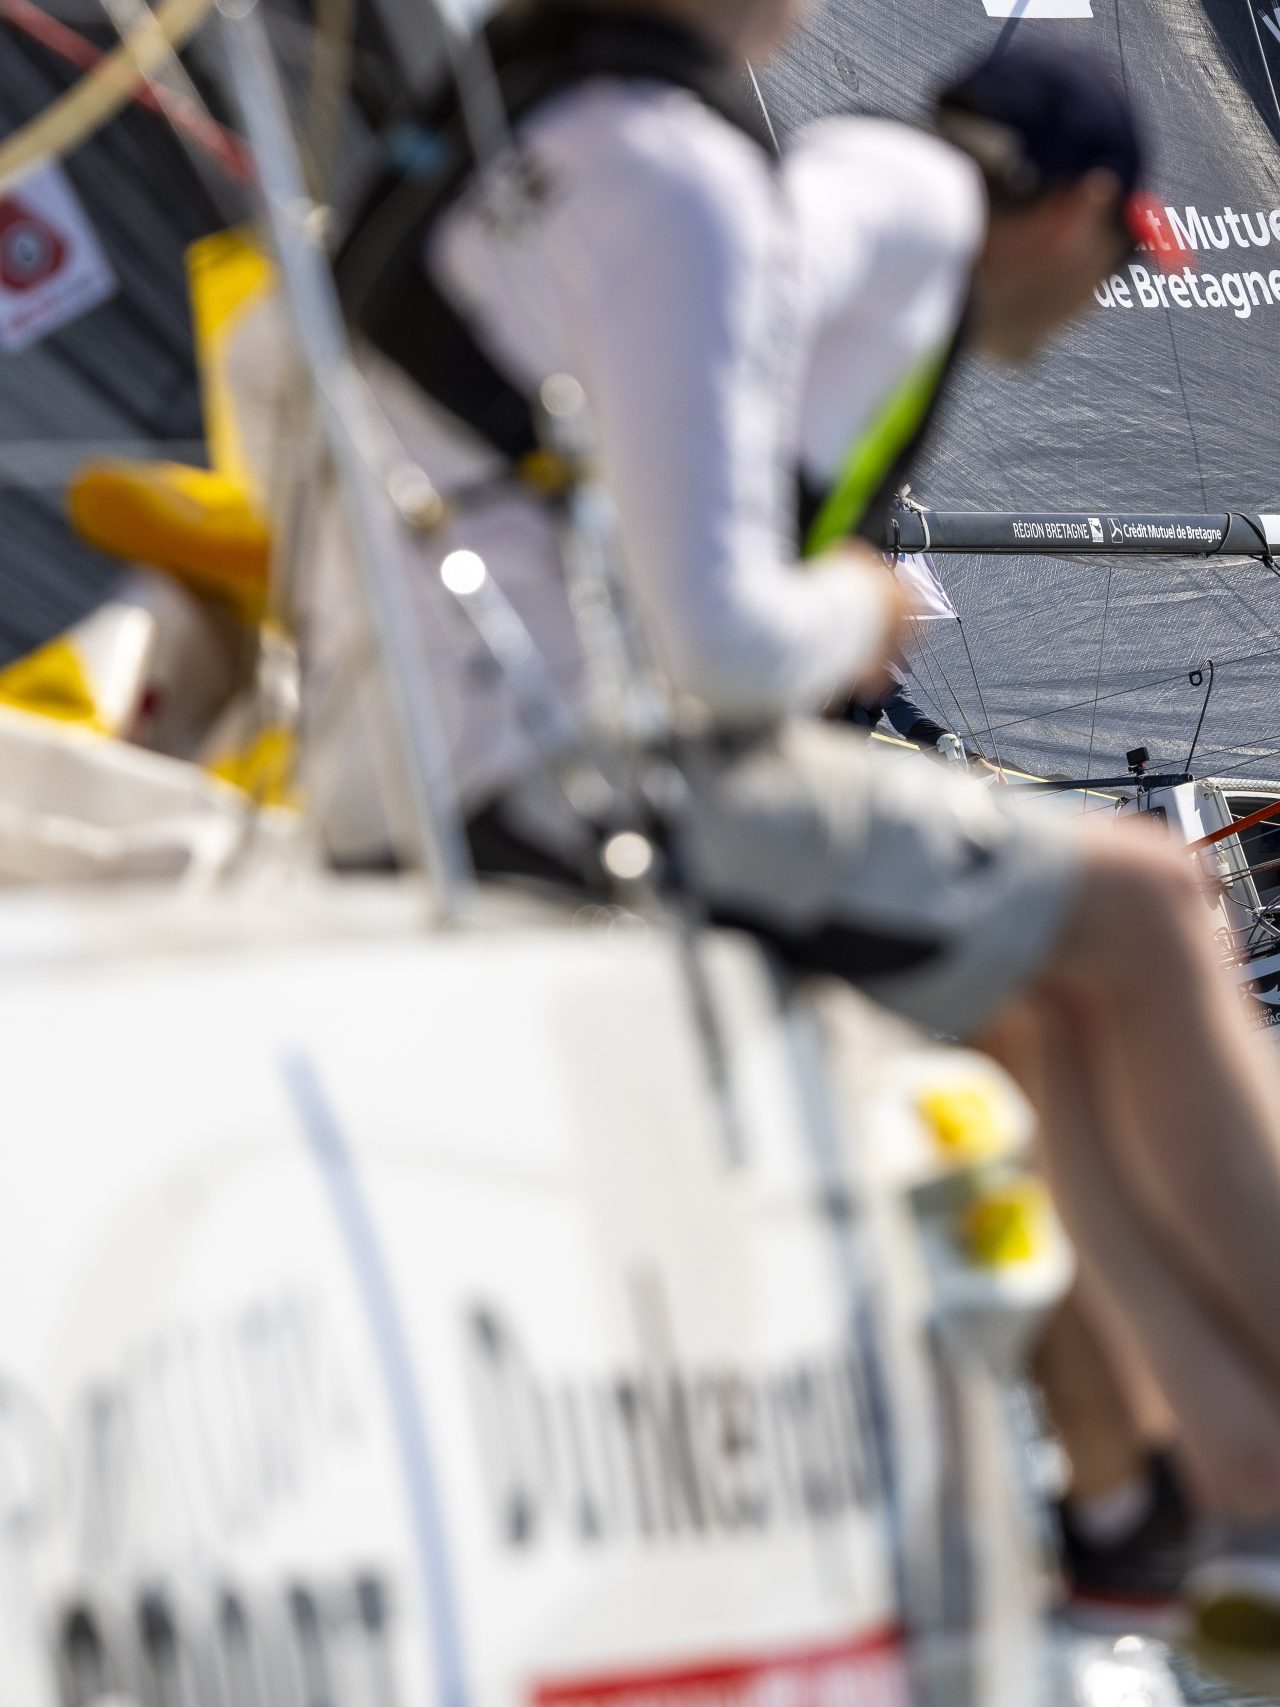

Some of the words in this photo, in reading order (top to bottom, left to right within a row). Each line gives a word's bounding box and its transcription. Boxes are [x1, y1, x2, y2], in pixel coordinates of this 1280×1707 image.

[1012, 520, 1045, 539] RÉGION
[1046, 522, 1090, 539] BRETAGNE
[1123, 523, 1148, 539] Crédit
[1148, 524, 1176, 539] Mutuel
[1176, 526, 1187, 539] de
[1187, 526, 1222, 543] Bretagne
